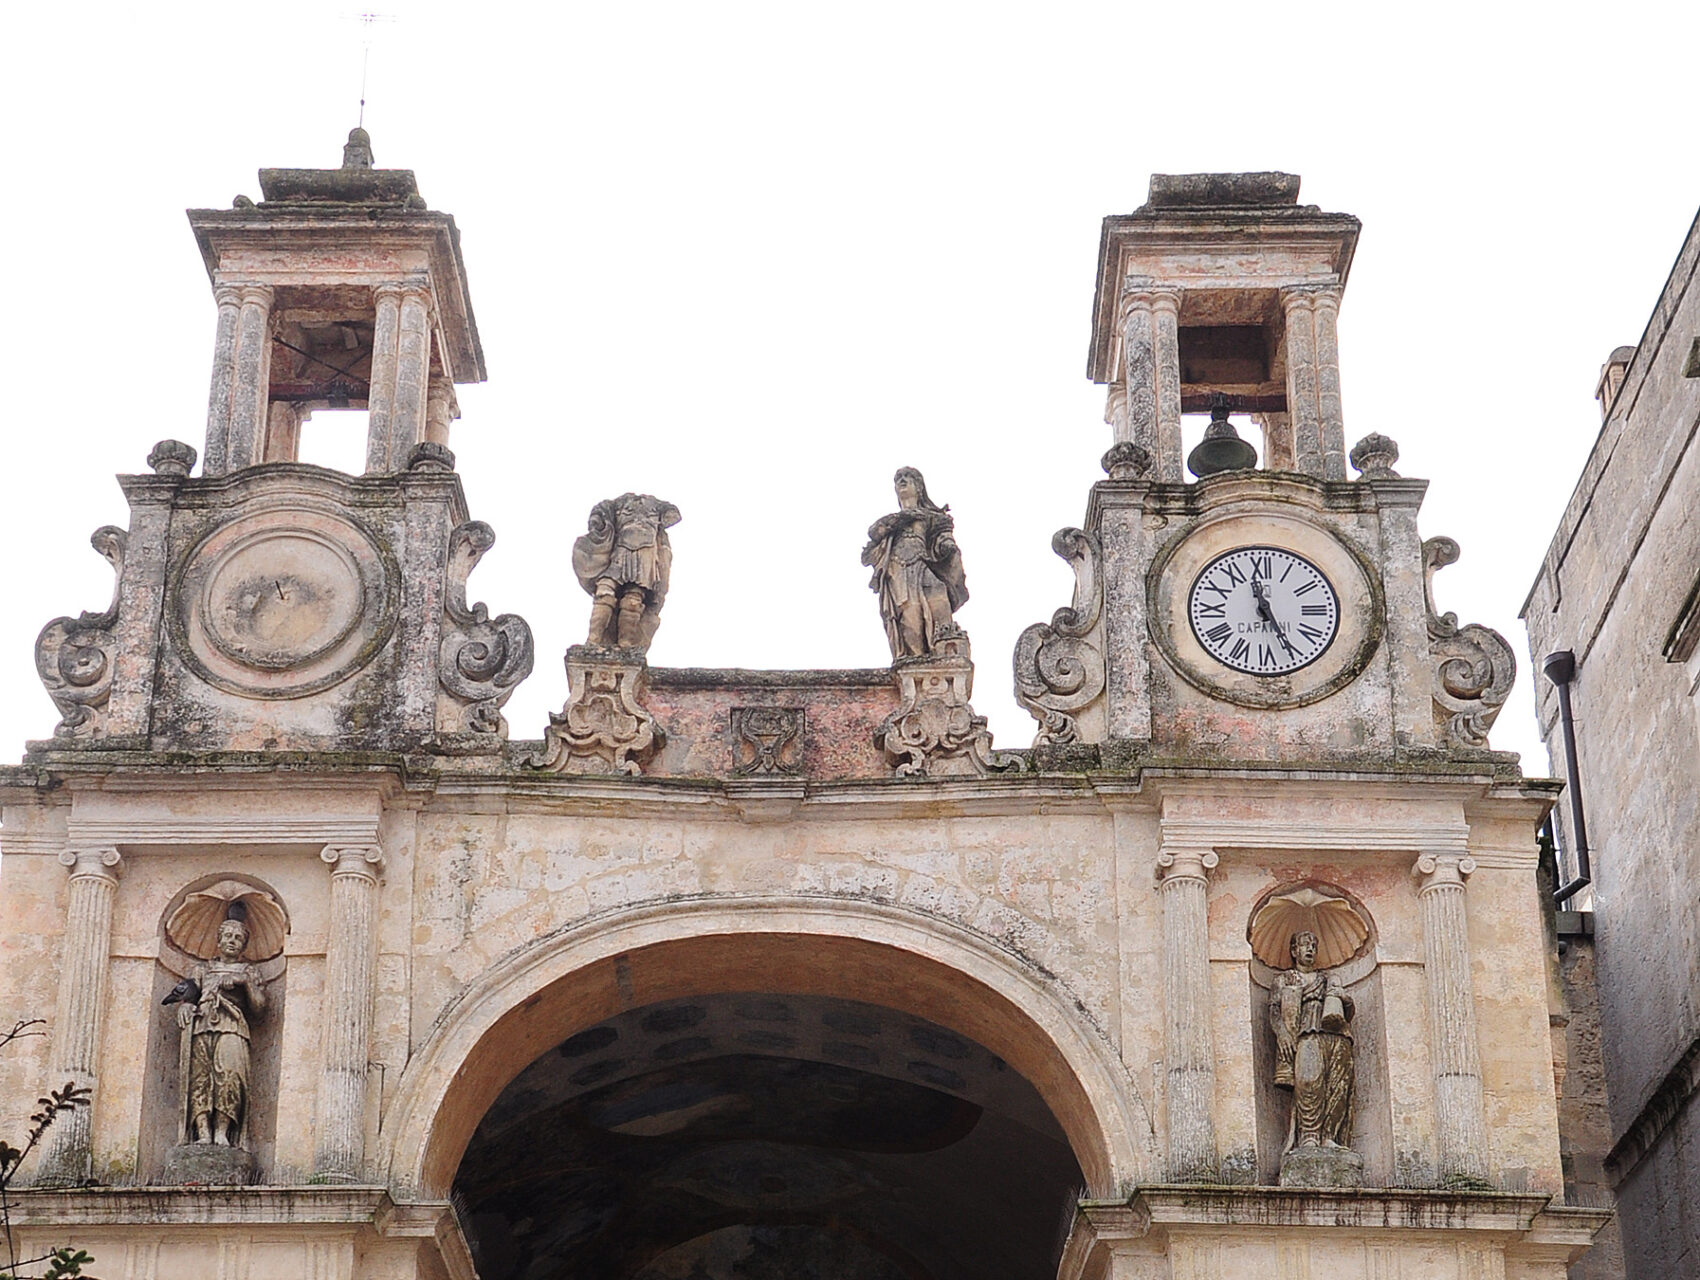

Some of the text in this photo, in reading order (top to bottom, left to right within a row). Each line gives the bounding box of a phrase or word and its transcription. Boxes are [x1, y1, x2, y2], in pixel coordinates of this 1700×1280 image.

[1220, 561, 1247, 588] XI
[1250, 556, 1271, 579] XII
[1280, 563, 1293, 583] I
[1204, 580, 1232, 600] X
[1293, 580, 1318, 597] II
[1199, 602, 1225, 618] IX
[1301, 605, 1327, 616] III
[1205, 622, 1234, 649] VIII
[1229, 637, 1250, 664] VII
[1259, 644, 1277, 667] VI
